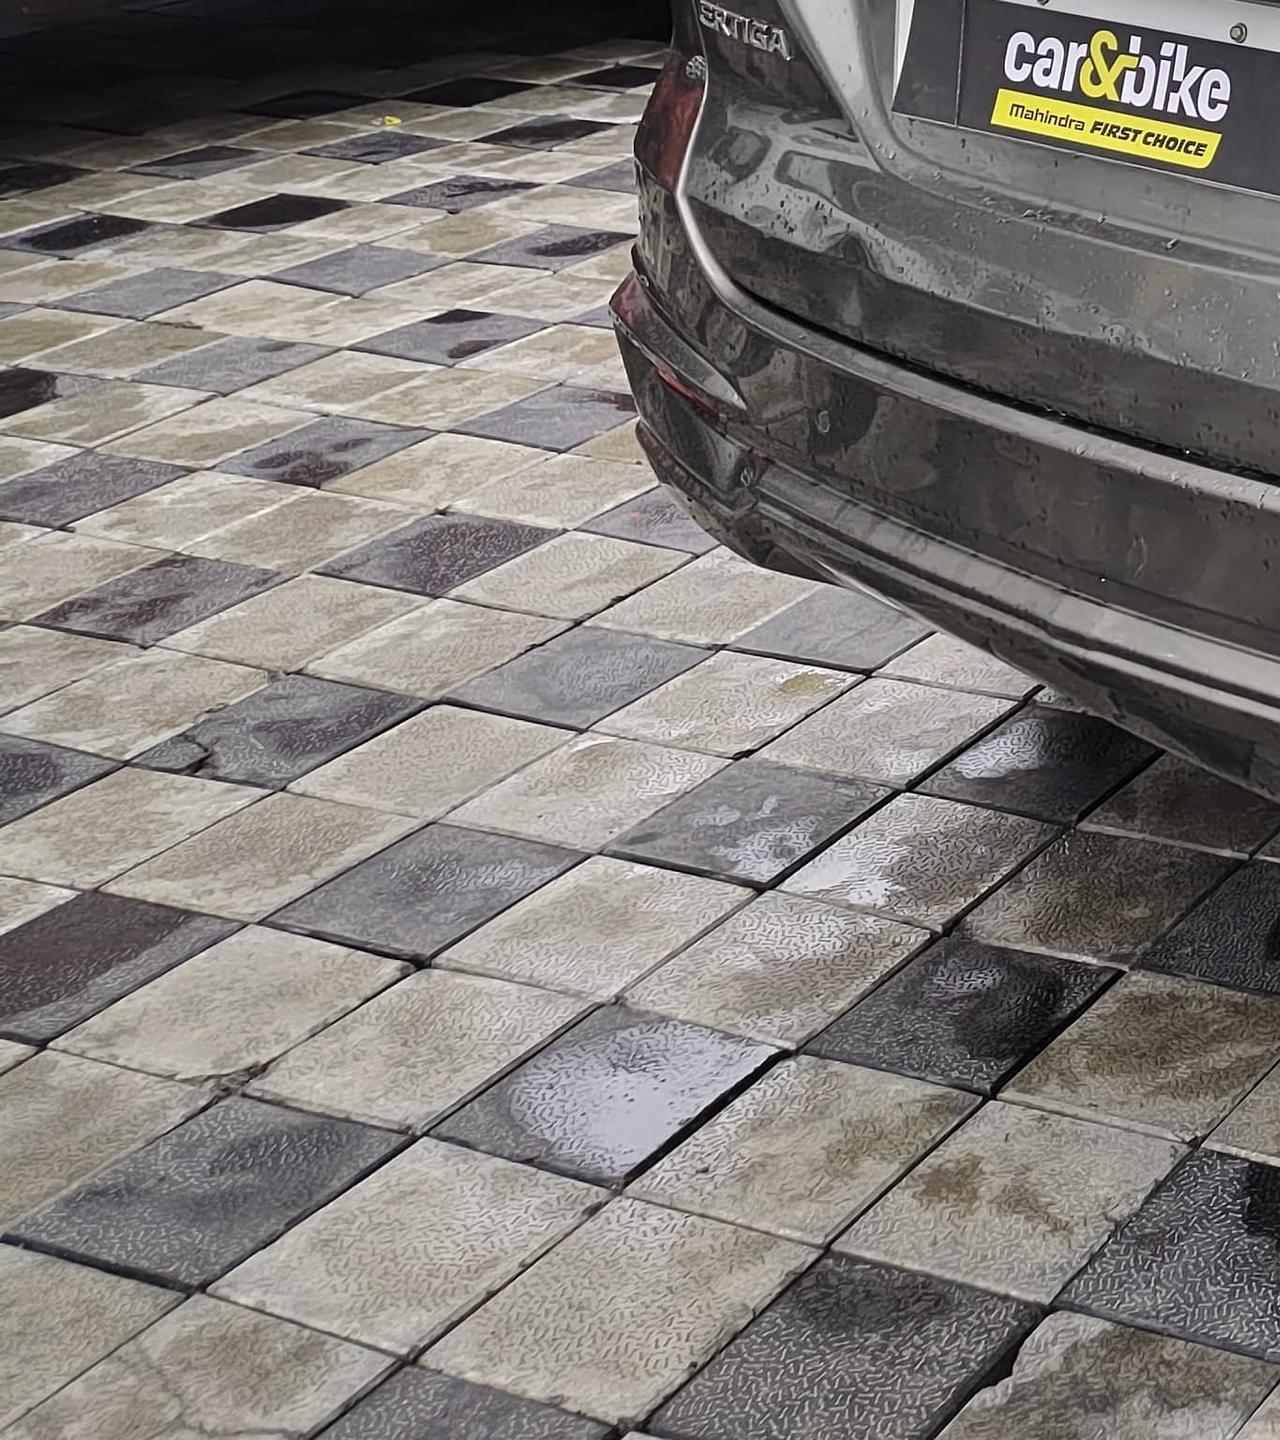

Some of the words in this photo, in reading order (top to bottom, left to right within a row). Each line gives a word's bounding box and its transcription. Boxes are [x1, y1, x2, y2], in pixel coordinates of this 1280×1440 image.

[699, 0, 793, 61] ERTIGA
[1003, 29, 1232, 123] car&bike
[1008, 102, 1086, 133] Mahindra
[1089, 119, 1143, 144] FIRST
[1142, 130, 1208, 158] CHOICE
